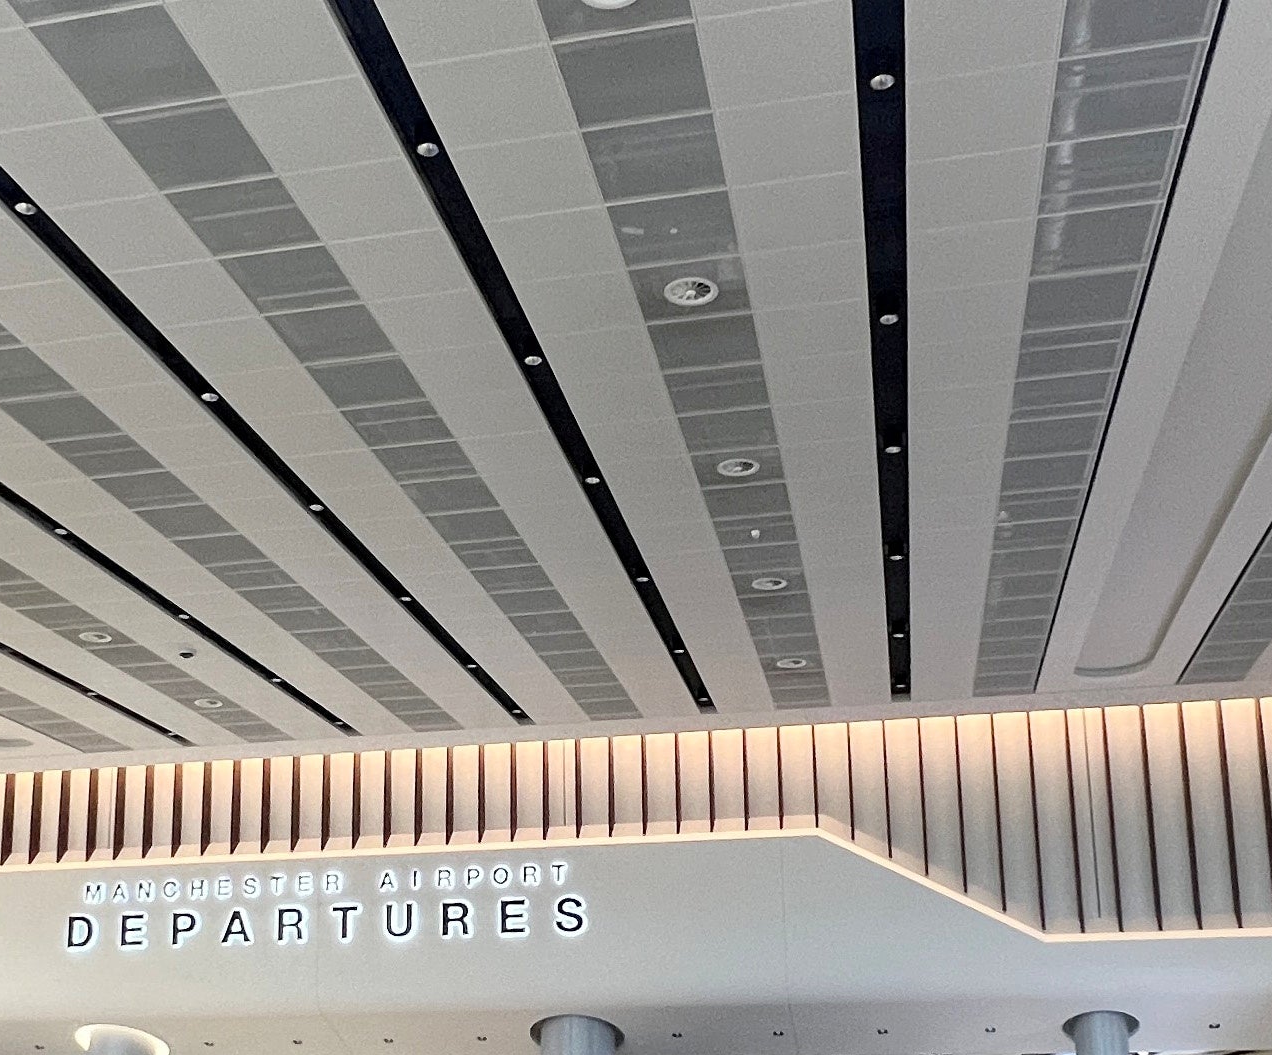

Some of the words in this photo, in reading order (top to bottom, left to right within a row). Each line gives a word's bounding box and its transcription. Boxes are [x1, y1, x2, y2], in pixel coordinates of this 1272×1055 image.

[84, 873, 341, 901] MANCHESTER
[379, 863, 566, 890] AIRPORT
[66, 897, 584, 948] DEPARTURES
